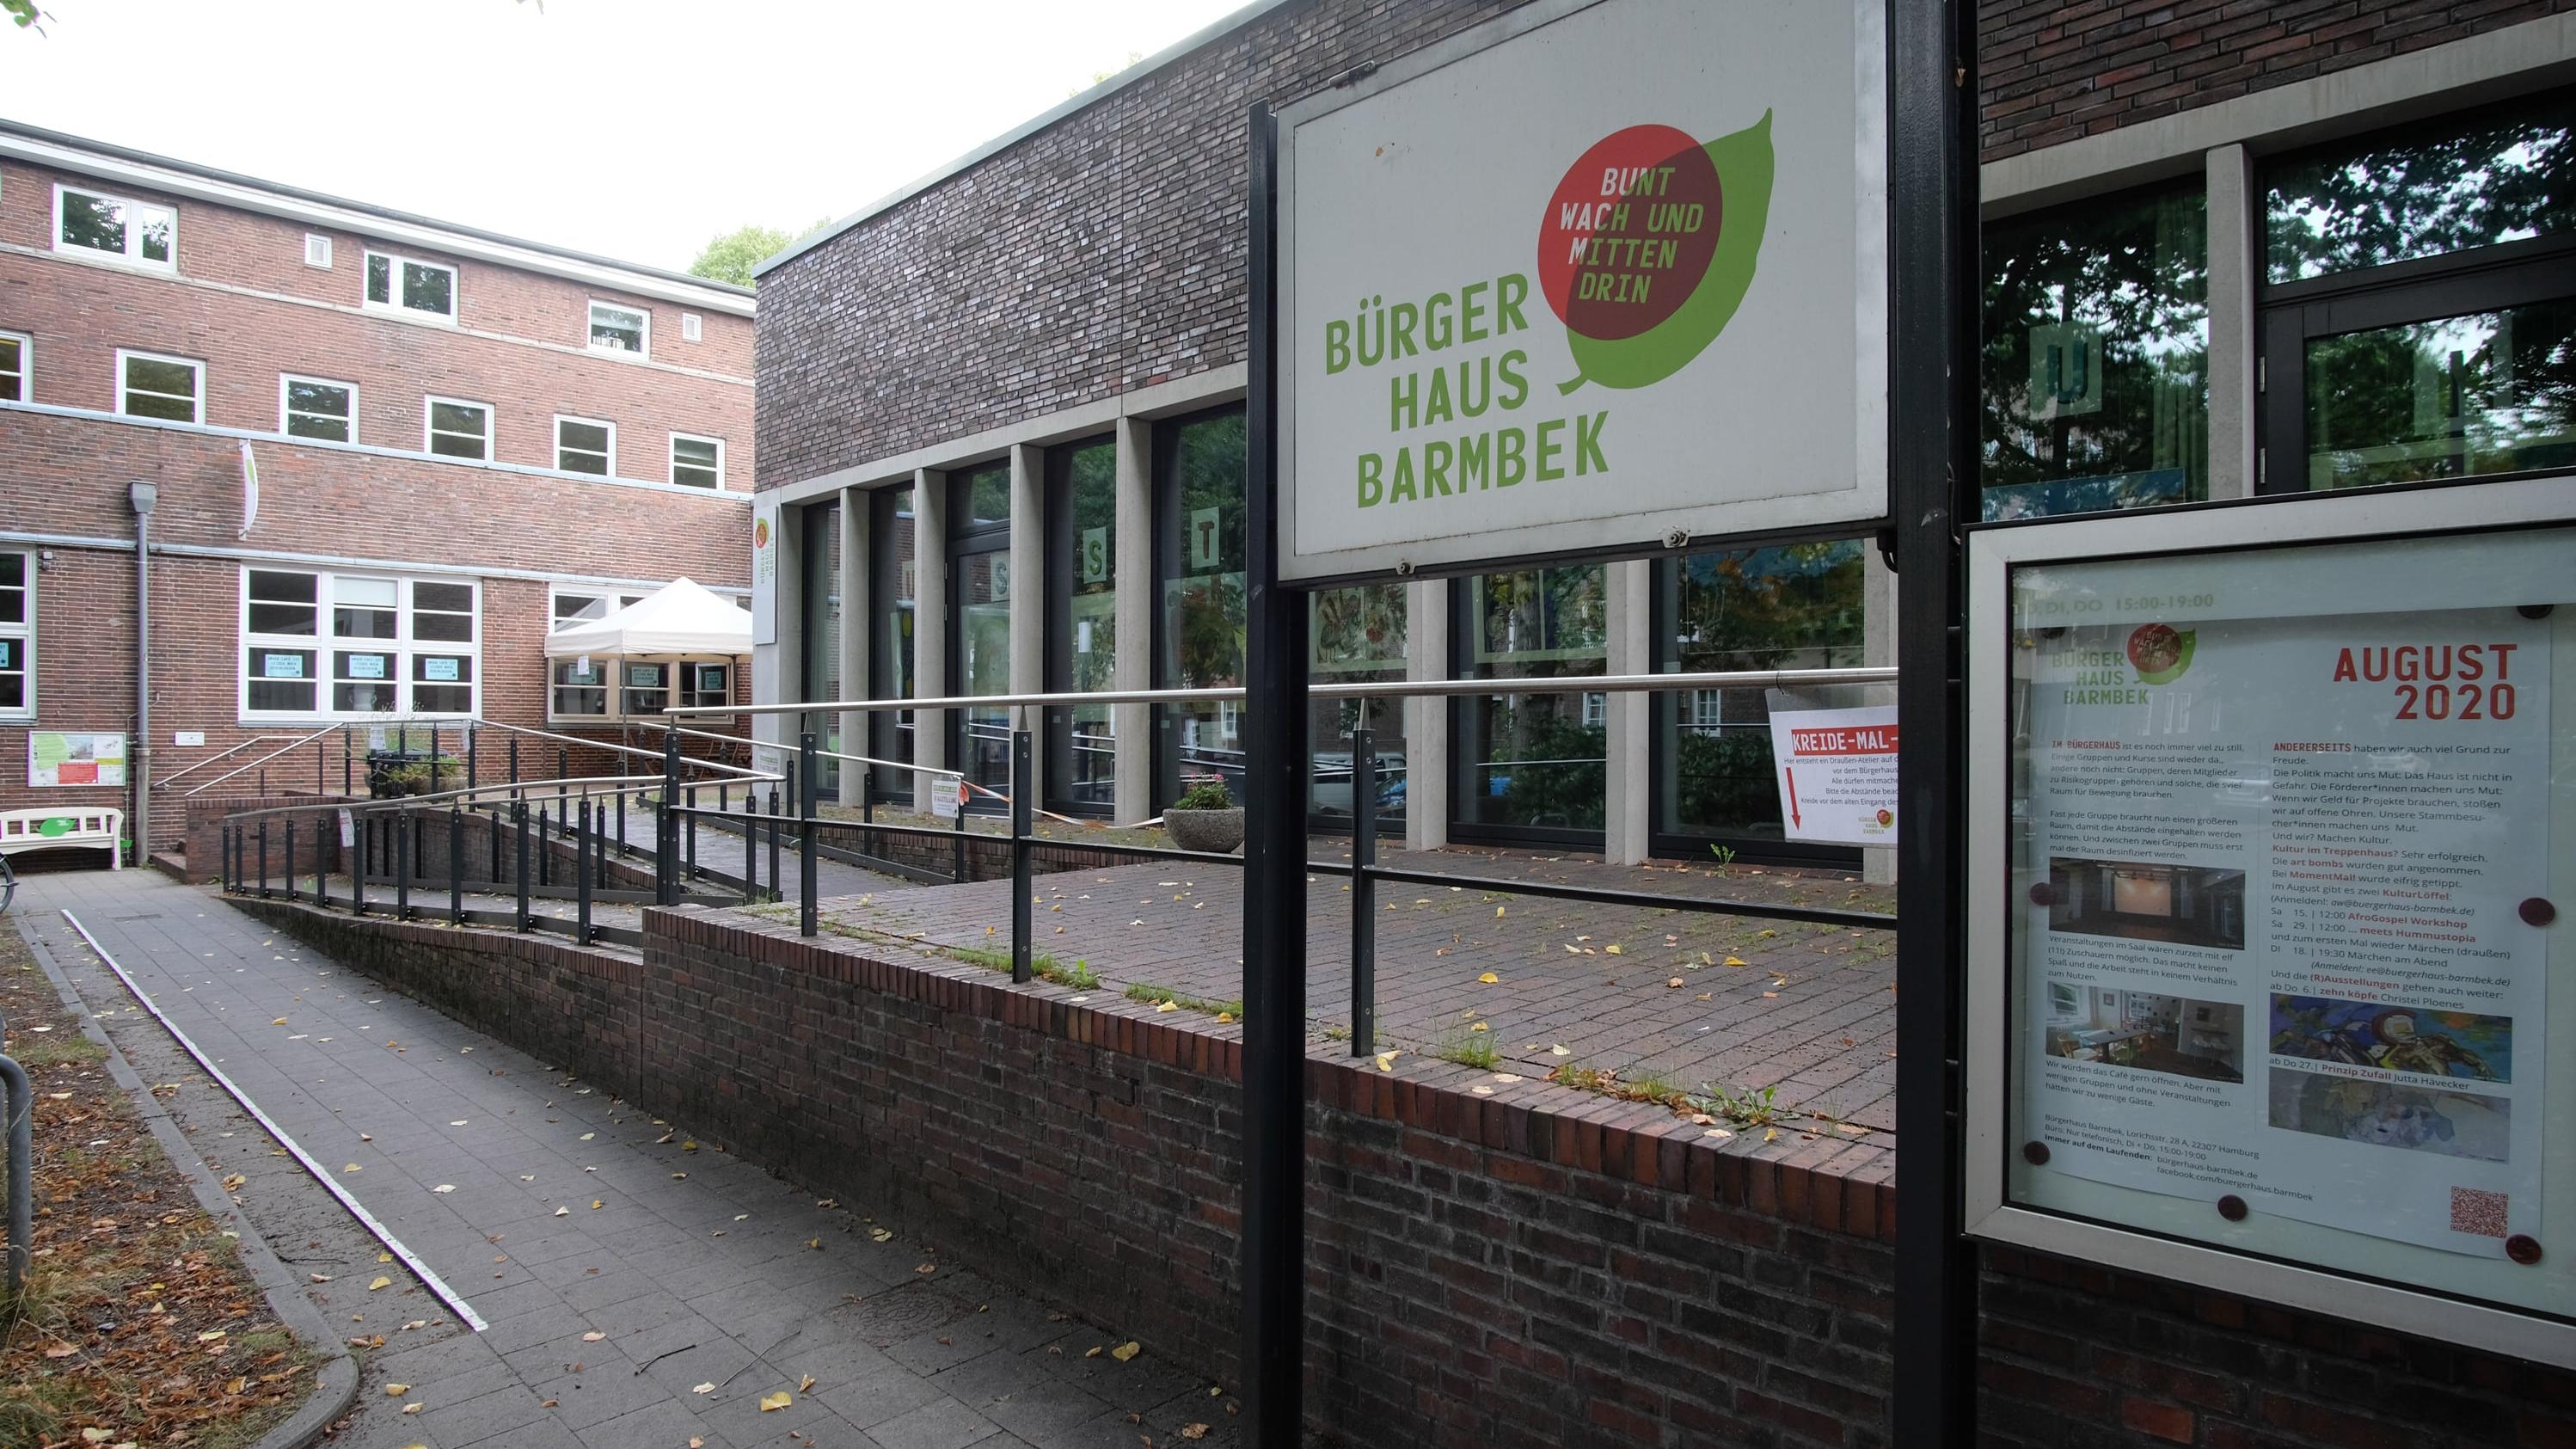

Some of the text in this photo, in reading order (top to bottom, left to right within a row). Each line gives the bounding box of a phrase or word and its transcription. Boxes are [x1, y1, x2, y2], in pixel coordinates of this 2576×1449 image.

[1601, 167, 1675, 197] BUNT
[1561, 203, 1704, 233] WACH UND
[1568, 236, 1677, 268] MITTEN
[1578, 273, 1652, 304] DRIN
[1325, 273, 1530, 375] BÜRGER
[2047, 341, 2088, 404] U
[1389, 350, 1529, 433] HAUS
[1357, 411, 1610, 509] BARMBEK
[996, 562, 1008, 594] S
[1089, 539, 1102, 576] S
[1197, 520, 1215, 559] T
[2076, 599, 2103, 612] DO
[2116, 594, 2214, 611] 15:00-19:00
[2052, 650, 2125, 667] BÜRGER
[2334, 643, 2518, 683] AUGUST
[2076, 671, 2124, 686] HAUS
[2064, 689, 2149, 704] BARMBEK
[2394, 684, 2516, 721] 2020
[2067, 740, 2120, 749] BÜRGERHAUS
[2273, 743, 2352, 752] ANDERERSEITS
[1861, 798, 1886, 807] Eingang
[2087, 812, 2118, 821] Gruppe
[2309, 859, 2343, 868] bombs
[2387, 863, 2403, 872] gut
[2286, 884, 2320, 893] August
[2322, 885, 2341, 895] gibt
[2320, 910, 2346, 919] 12:00
[2346, 912, 2407, 925] AfroGospel
[2410, 918, 2467, 930] Workshop
[2315, 936, 2346, 945] ersten
[2350, 938, 2367, 947] Mal
[2371, 941, 2405, 949] wieder
[2320, 923, 2346, 932] 12:00
[2359, 927, 2393, 936] meets
[2396, 930, 2475, 942] Hummustopia
[2292, 972, 2308, 980] die
[2309, 973, 2399, 990] (R)Ausstellungen
[2402, 982, 2435, 993] gehen
[2437, 985, 2463, 995] auch
[2284, 983, 2297, 992] Do
[2320, 987, 2344, 996] zehn
[2380, 993, 2419, 1004] Christel
[2423, 998, 2464, 1009] Ploenes
[2283, 1059, 2296, 1067] Do
[2321, 1064, 2358, 1077] Prinzip
[2360, 1069, 2390, 1080] Zufall
[2395, 1073, 2417, 1084] Jutta
[2044, 1134, 2070, 1145] Immer
[2086, 1142, 2103, 1151] dem
[2169, 1136, 2180, 1145] 28
[2218, 1145, 2259, 1159] Hamburg
